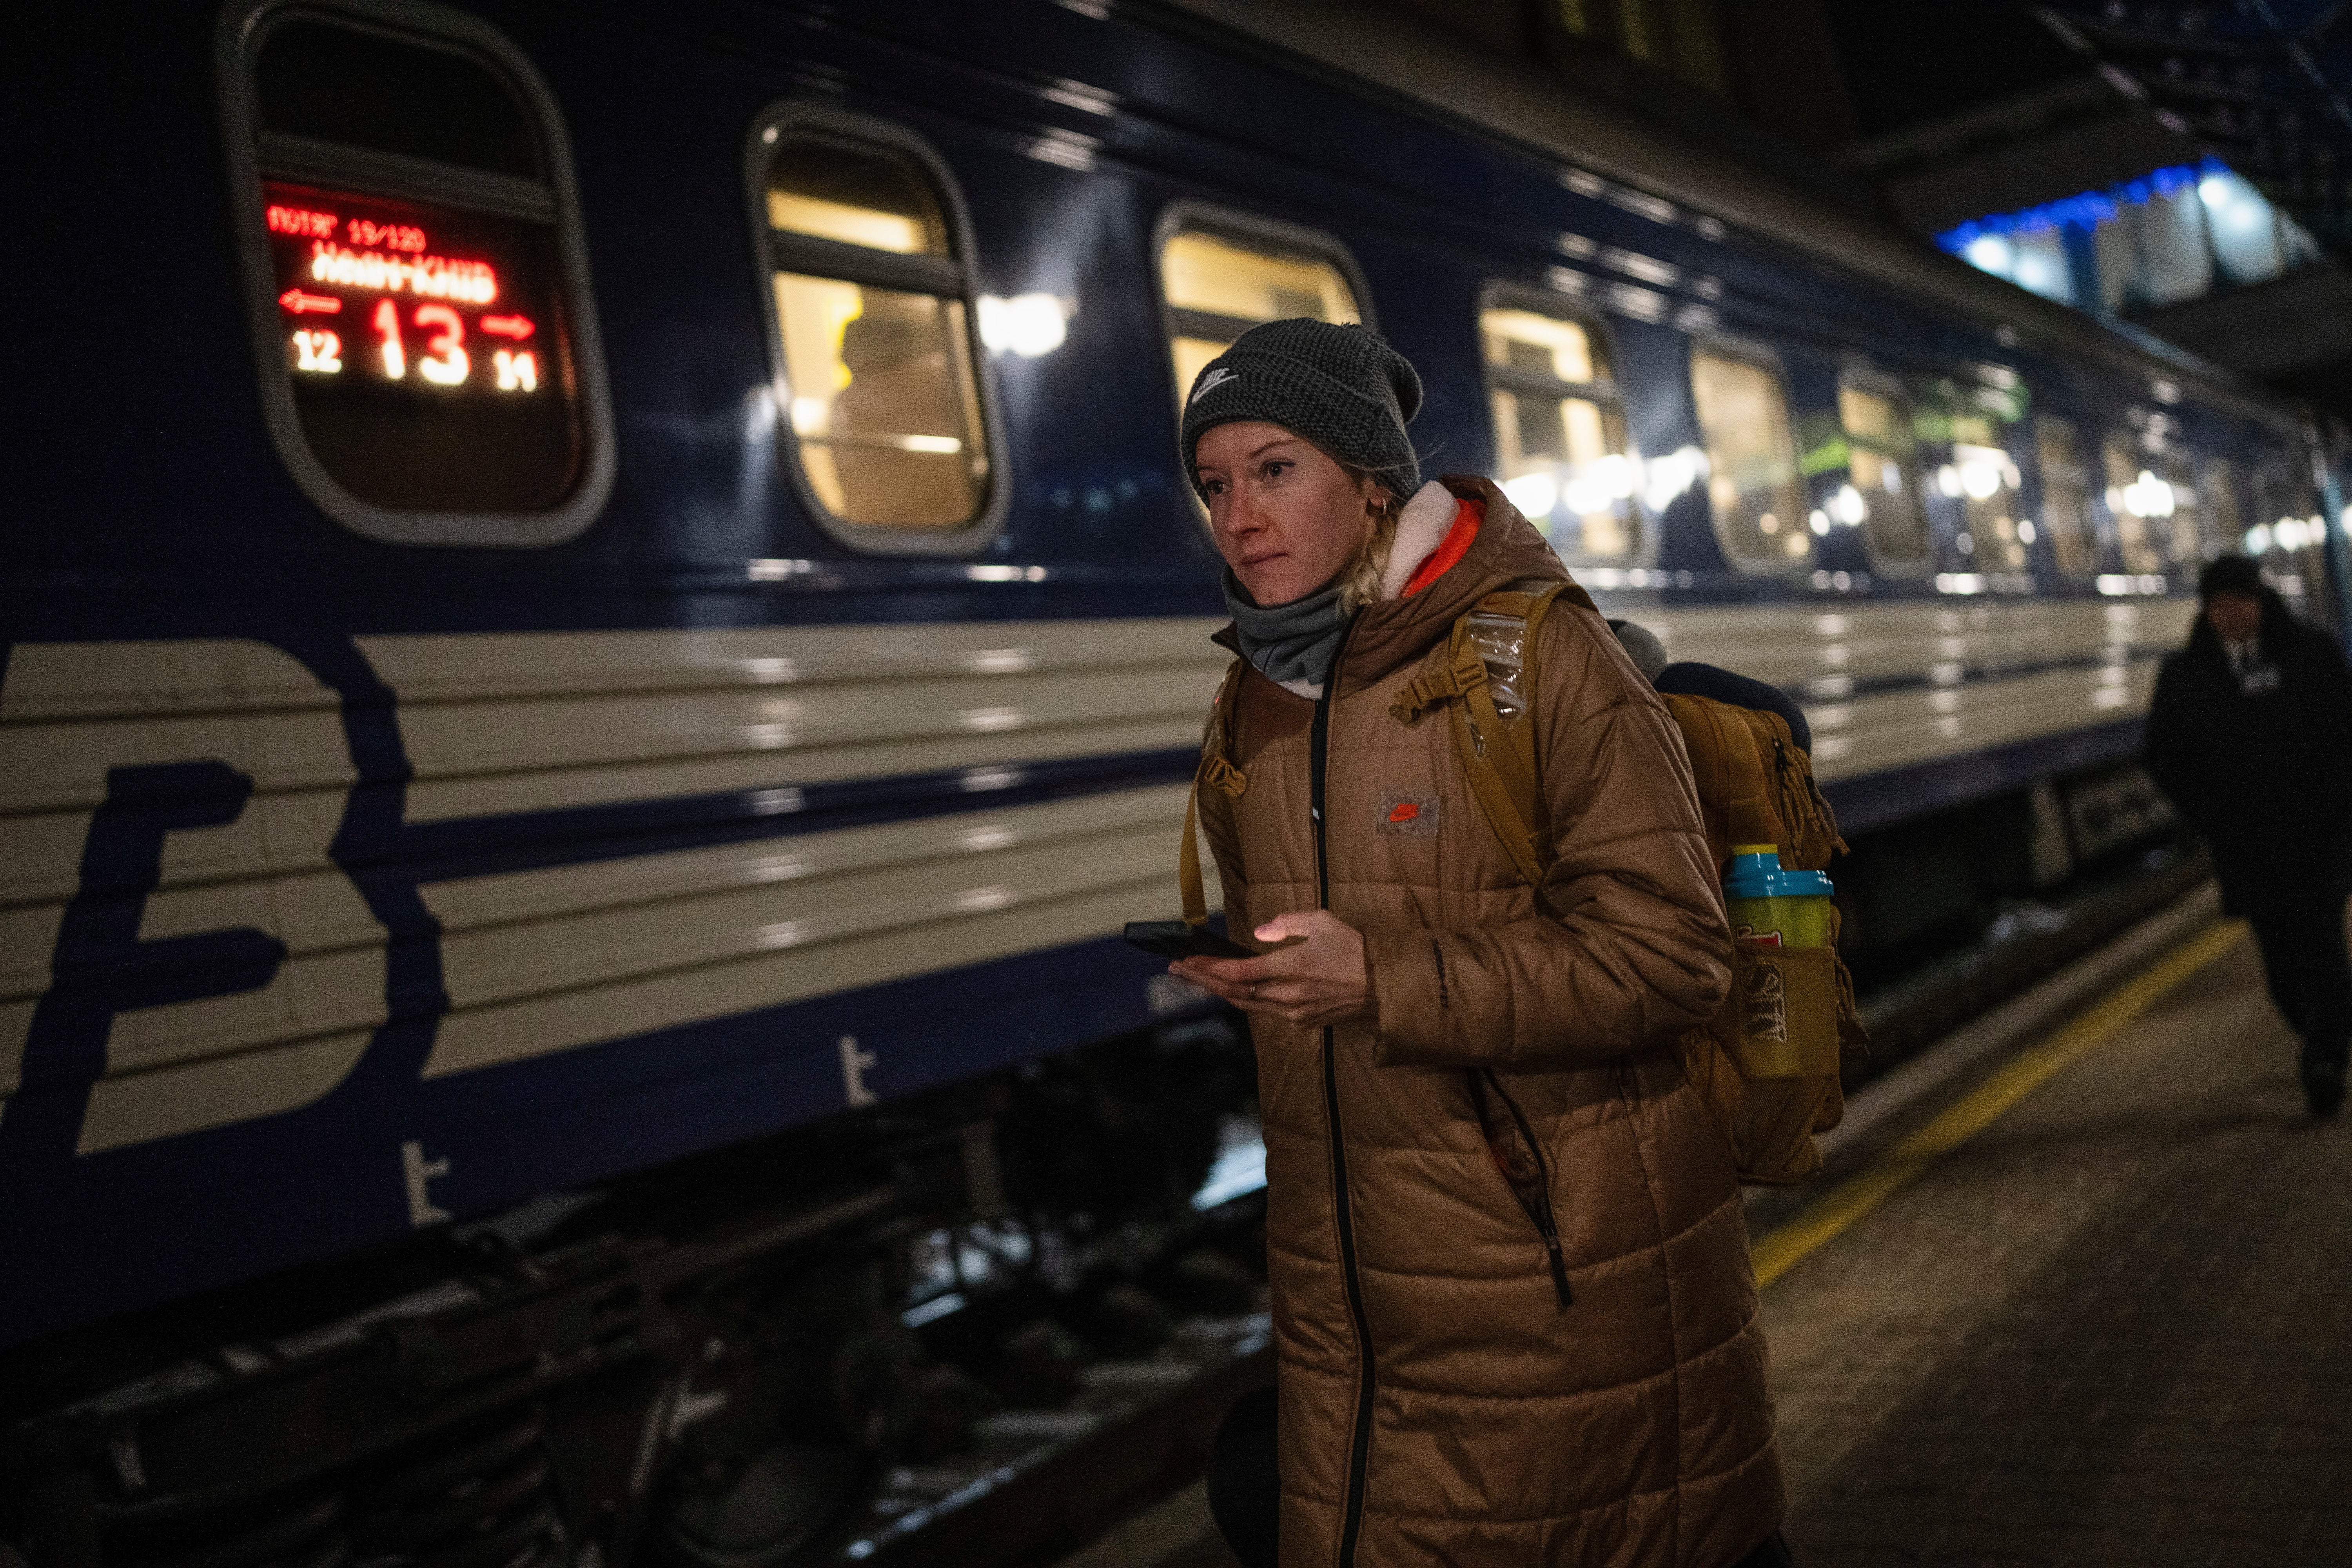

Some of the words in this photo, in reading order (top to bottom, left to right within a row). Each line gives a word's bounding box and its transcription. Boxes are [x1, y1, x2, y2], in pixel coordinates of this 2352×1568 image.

[293, 329, 342, 372] 12
[373, 298, 470, 385] 13
[494, 348, 537, 391] 14
